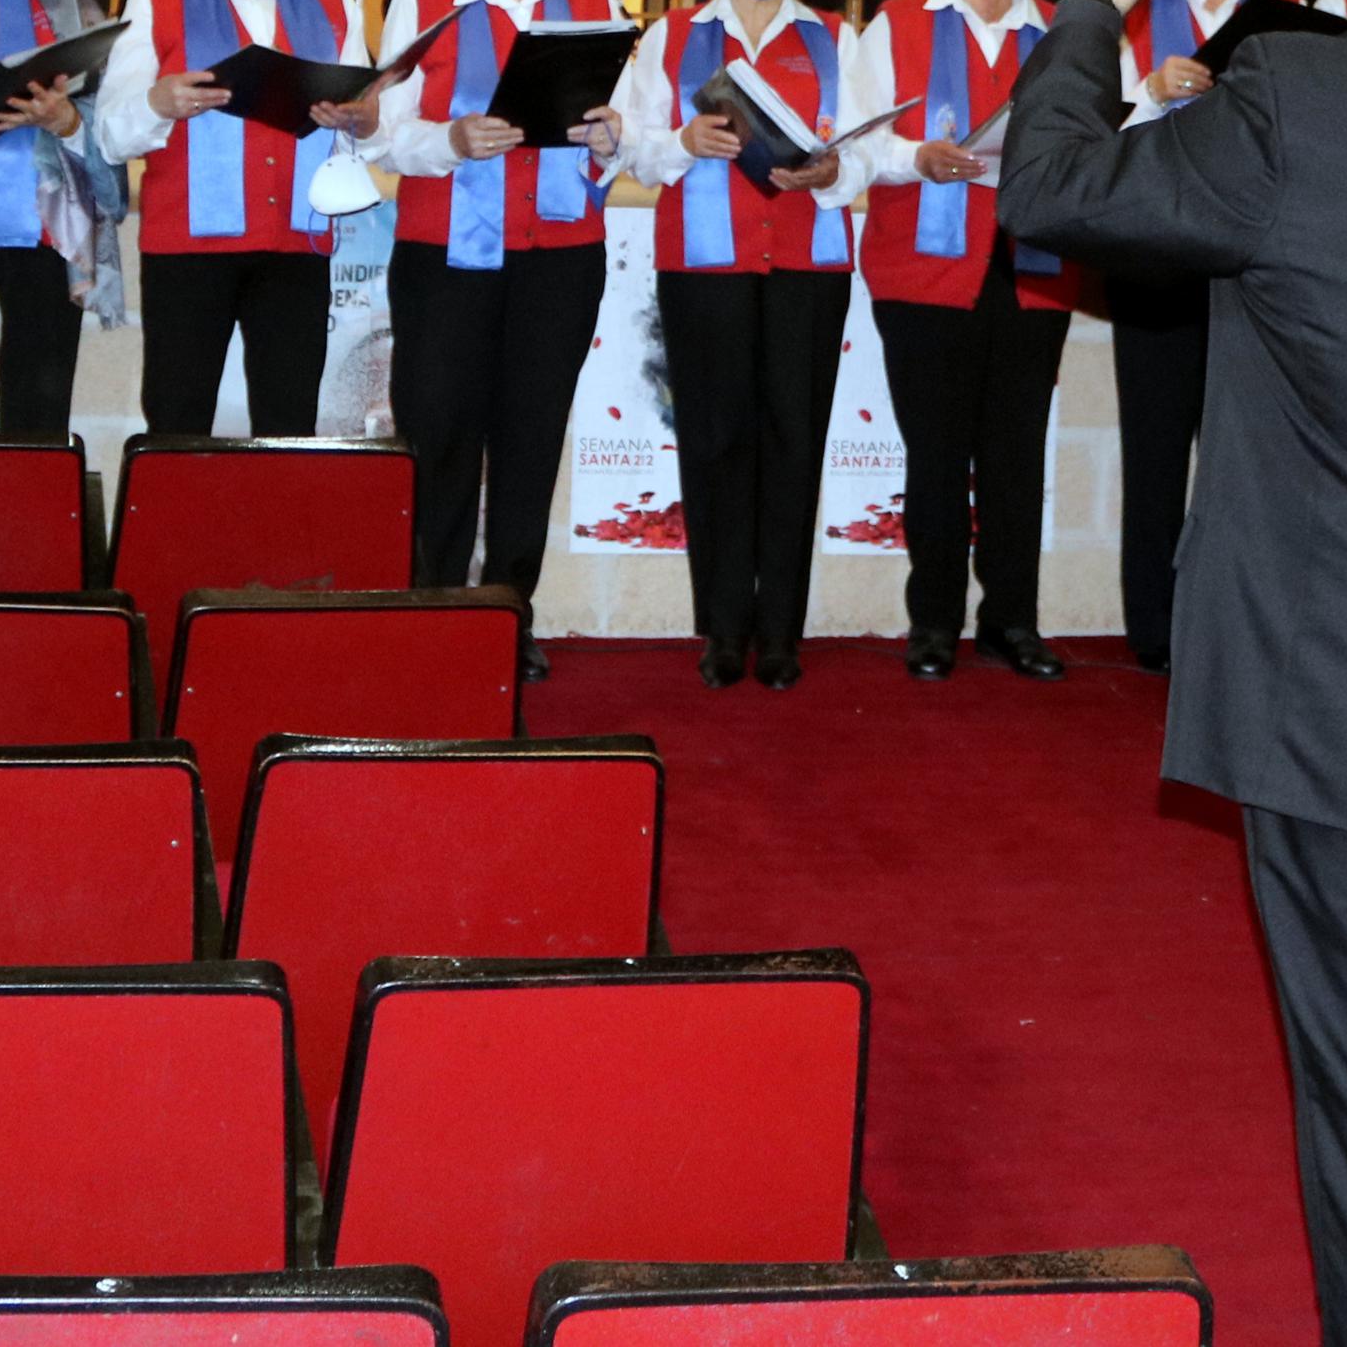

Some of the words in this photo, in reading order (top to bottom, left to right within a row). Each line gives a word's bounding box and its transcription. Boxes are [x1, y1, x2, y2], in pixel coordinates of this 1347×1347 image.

[579, 437, 653, 452] SEMANA
[830, 439, 904, 454] SEMANA
[579, 453, 630, 466] SANTA
[830, 455, 881, 468] SANTA
